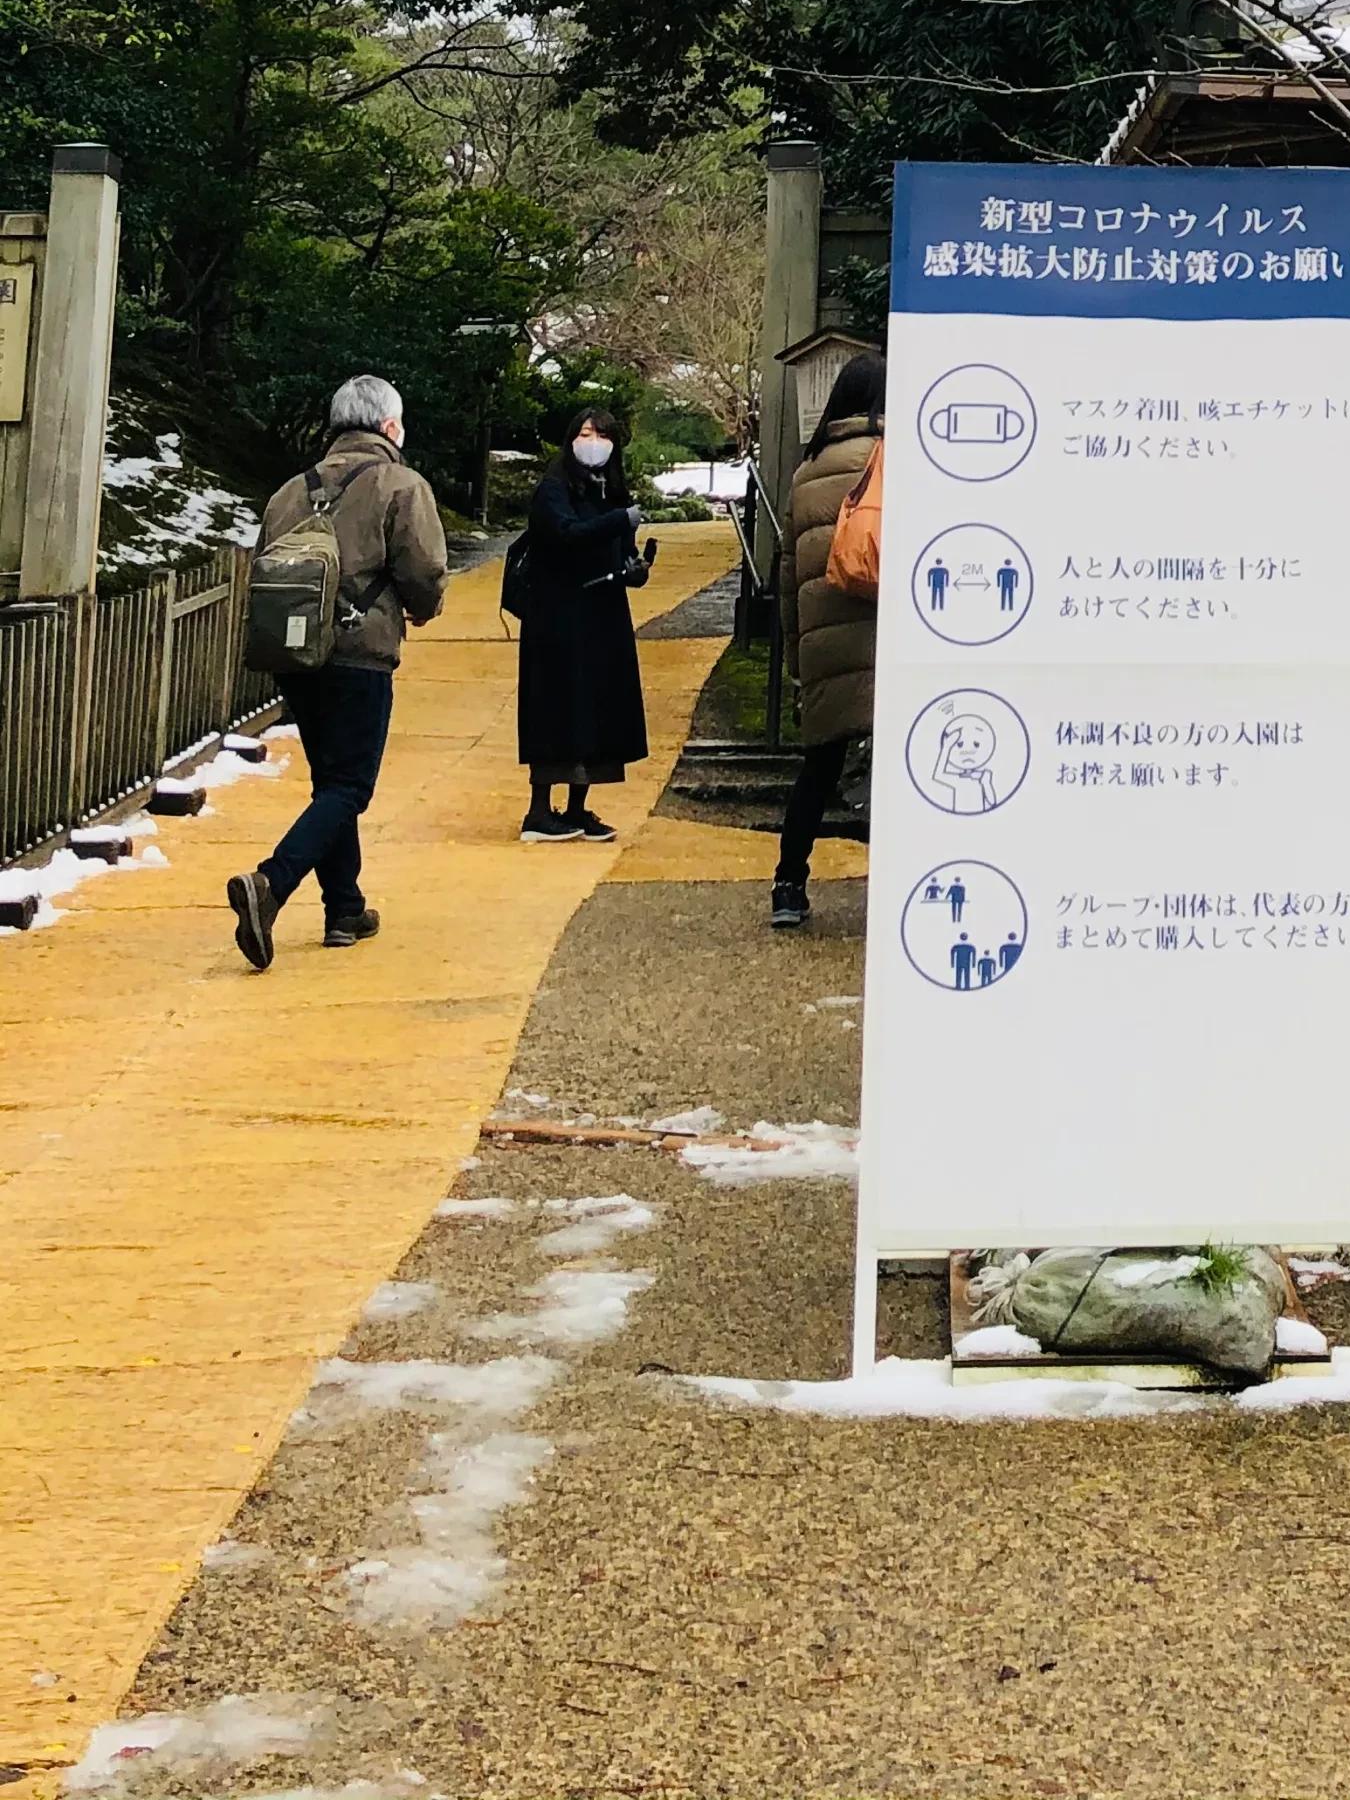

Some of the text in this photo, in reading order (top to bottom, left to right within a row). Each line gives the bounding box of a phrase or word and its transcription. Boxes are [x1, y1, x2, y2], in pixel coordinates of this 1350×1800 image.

[980, 197, 1307, 238] 新型コロナウイルス
[1062, 434, 1237, 460] ご協力ください。
[1059, 555, 1302, 582] 人と人の間隔を十分に
[1059, 595, 1239, 621] あけてください。
[1056, 721, 1304, 747] 体調不良の方の入園は
[1056, 761, 1239, 787] お控え願います。
